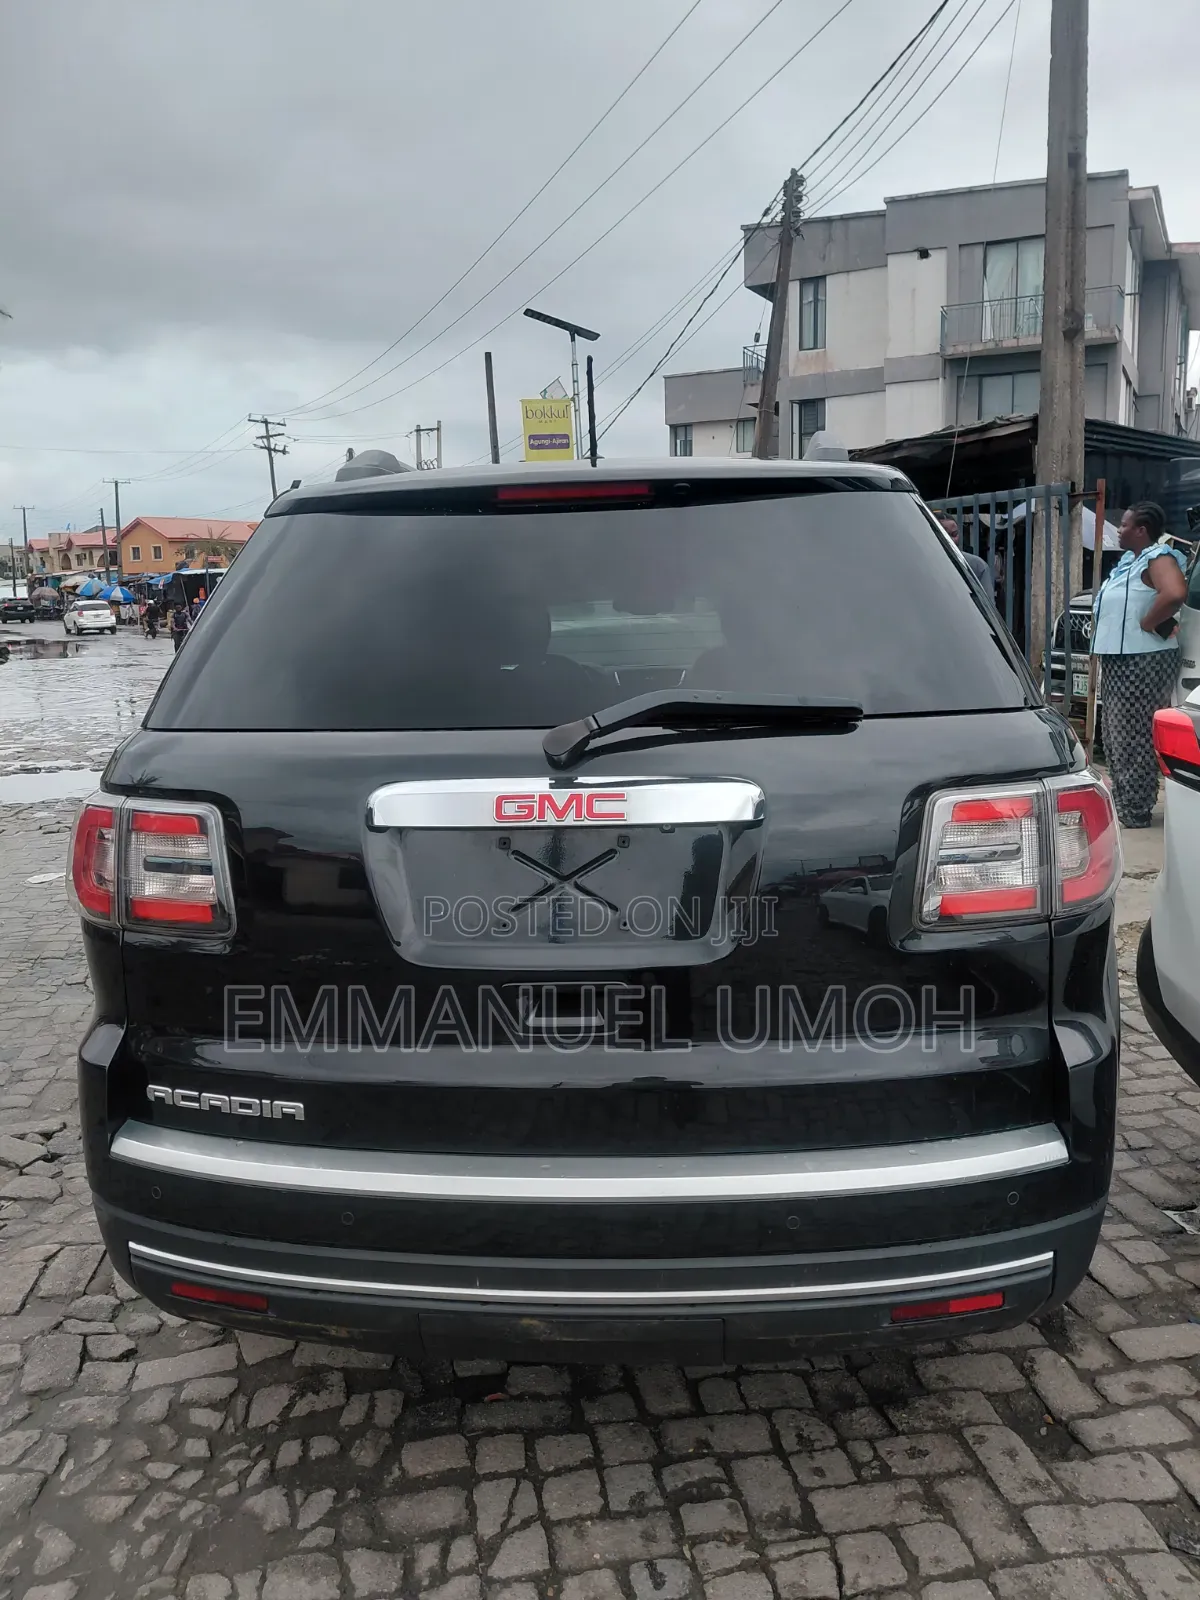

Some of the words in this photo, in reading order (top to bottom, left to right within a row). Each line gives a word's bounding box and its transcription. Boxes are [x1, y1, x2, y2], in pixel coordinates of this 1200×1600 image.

[1071, 662, 1089, 671] PRA
[493, 792, 627, 822] GMC
[146, 1084, 305, 1121] ACADIA
